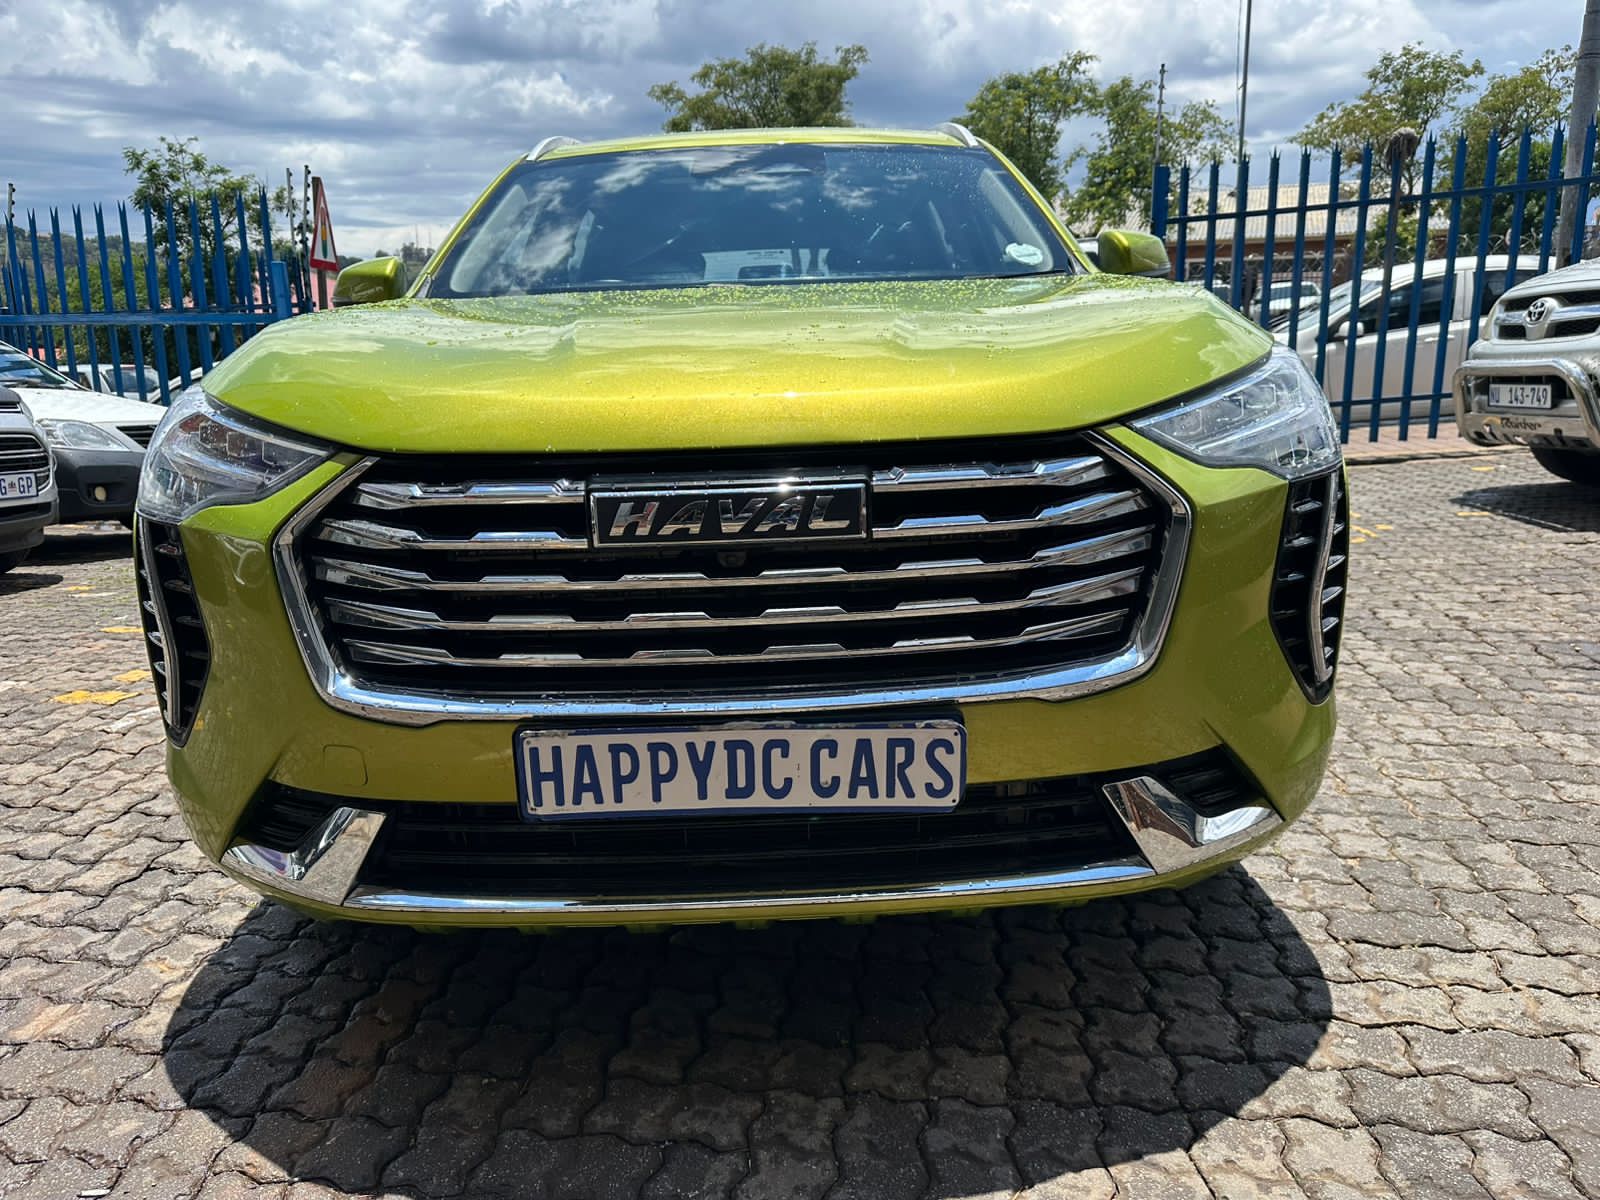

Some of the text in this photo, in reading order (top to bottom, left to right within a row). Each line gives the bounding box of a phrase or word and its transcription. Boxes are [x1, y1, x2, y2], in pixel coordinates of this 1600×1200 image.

[1509, 387, 1548, 404] 143-749
[18, 476, 33, 494] GP
[608, 495, 851, 537] HAVAL
[528, 737, 955, 807] HAPPYDC CARS
